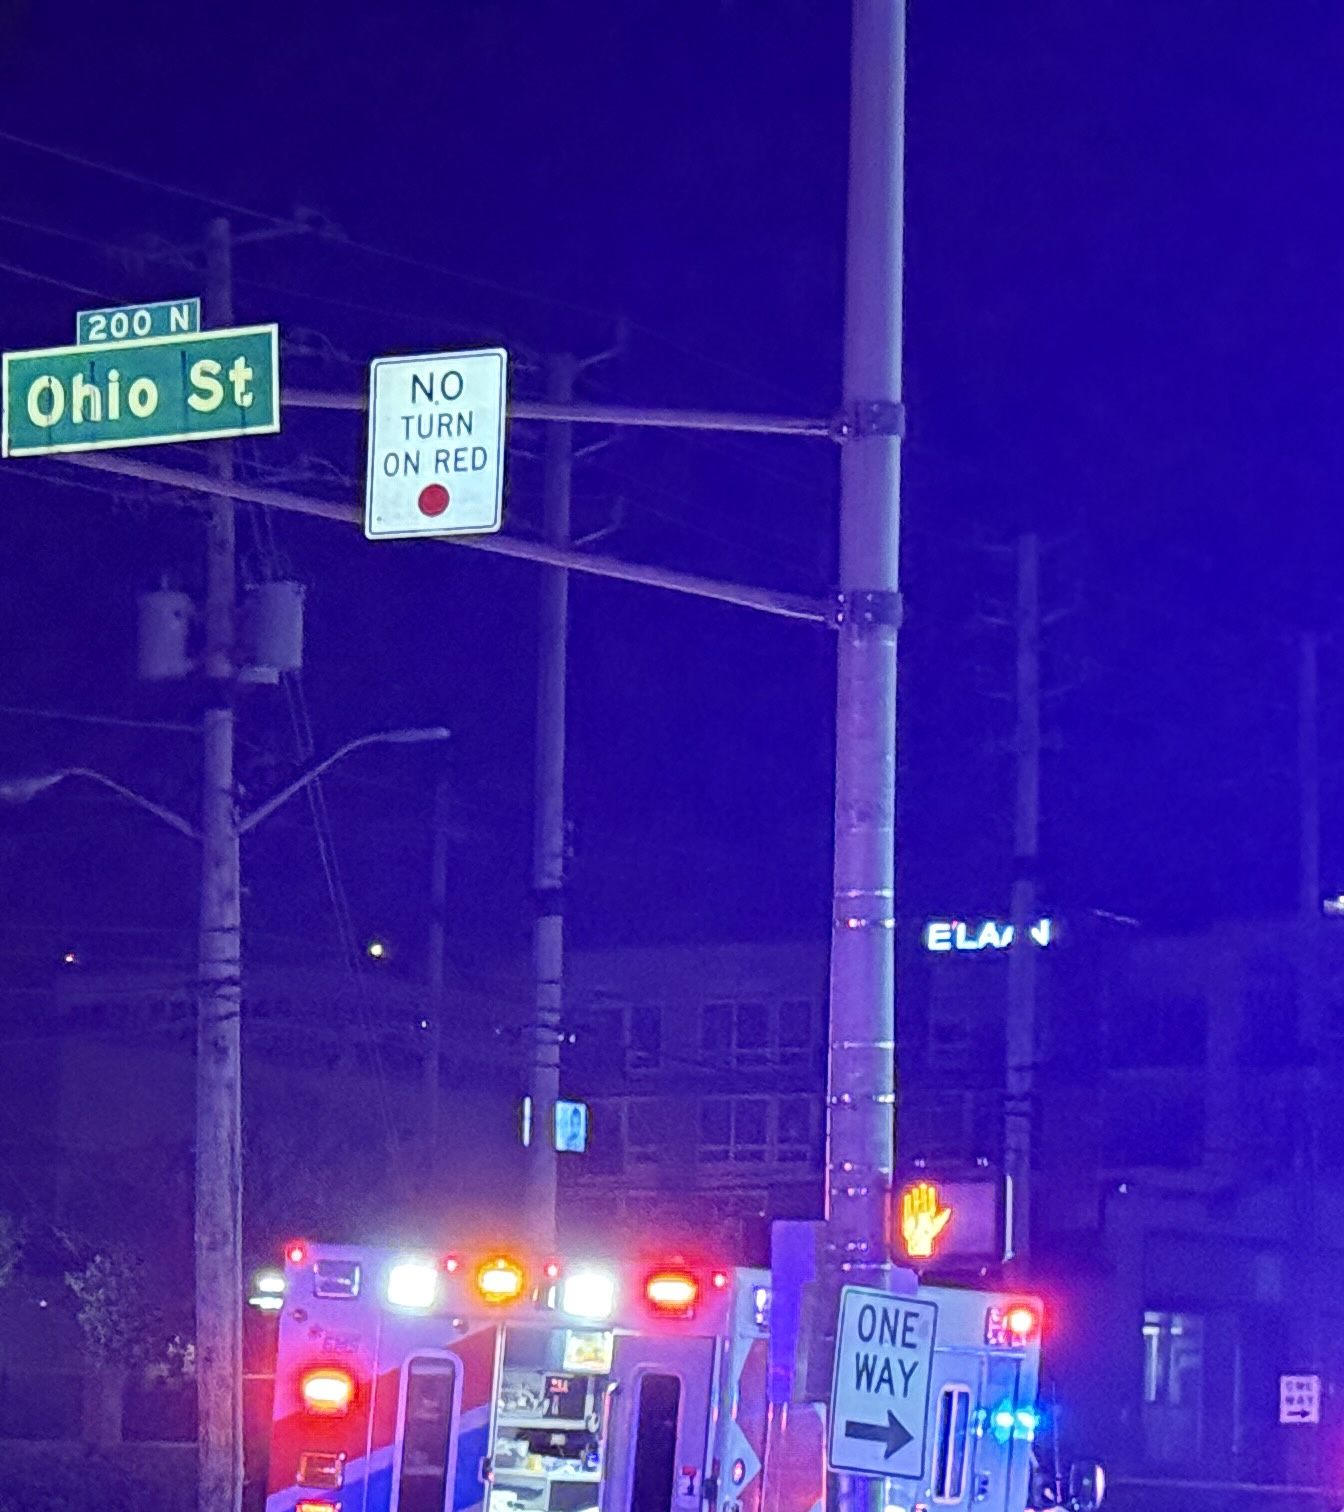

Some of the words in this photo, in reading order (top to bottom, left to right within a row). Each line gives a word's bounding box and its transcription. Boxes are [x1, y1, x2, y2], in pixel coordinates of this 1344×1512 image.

[88, 309, 152, 341] 200
[170, 304, 189, 332] N
[27, 368, 159, 427] Ohio
[187, 355, 254, 413] St
[411, 370, 464, 404] NO
[401, 411, 474, 440] TURN
[383, 450, 421, 477] ON
[434, 447, 488, 475] RED
[857, 1303, 920, 1350] ONE
[855, 1351, 919, 1398] WAY
